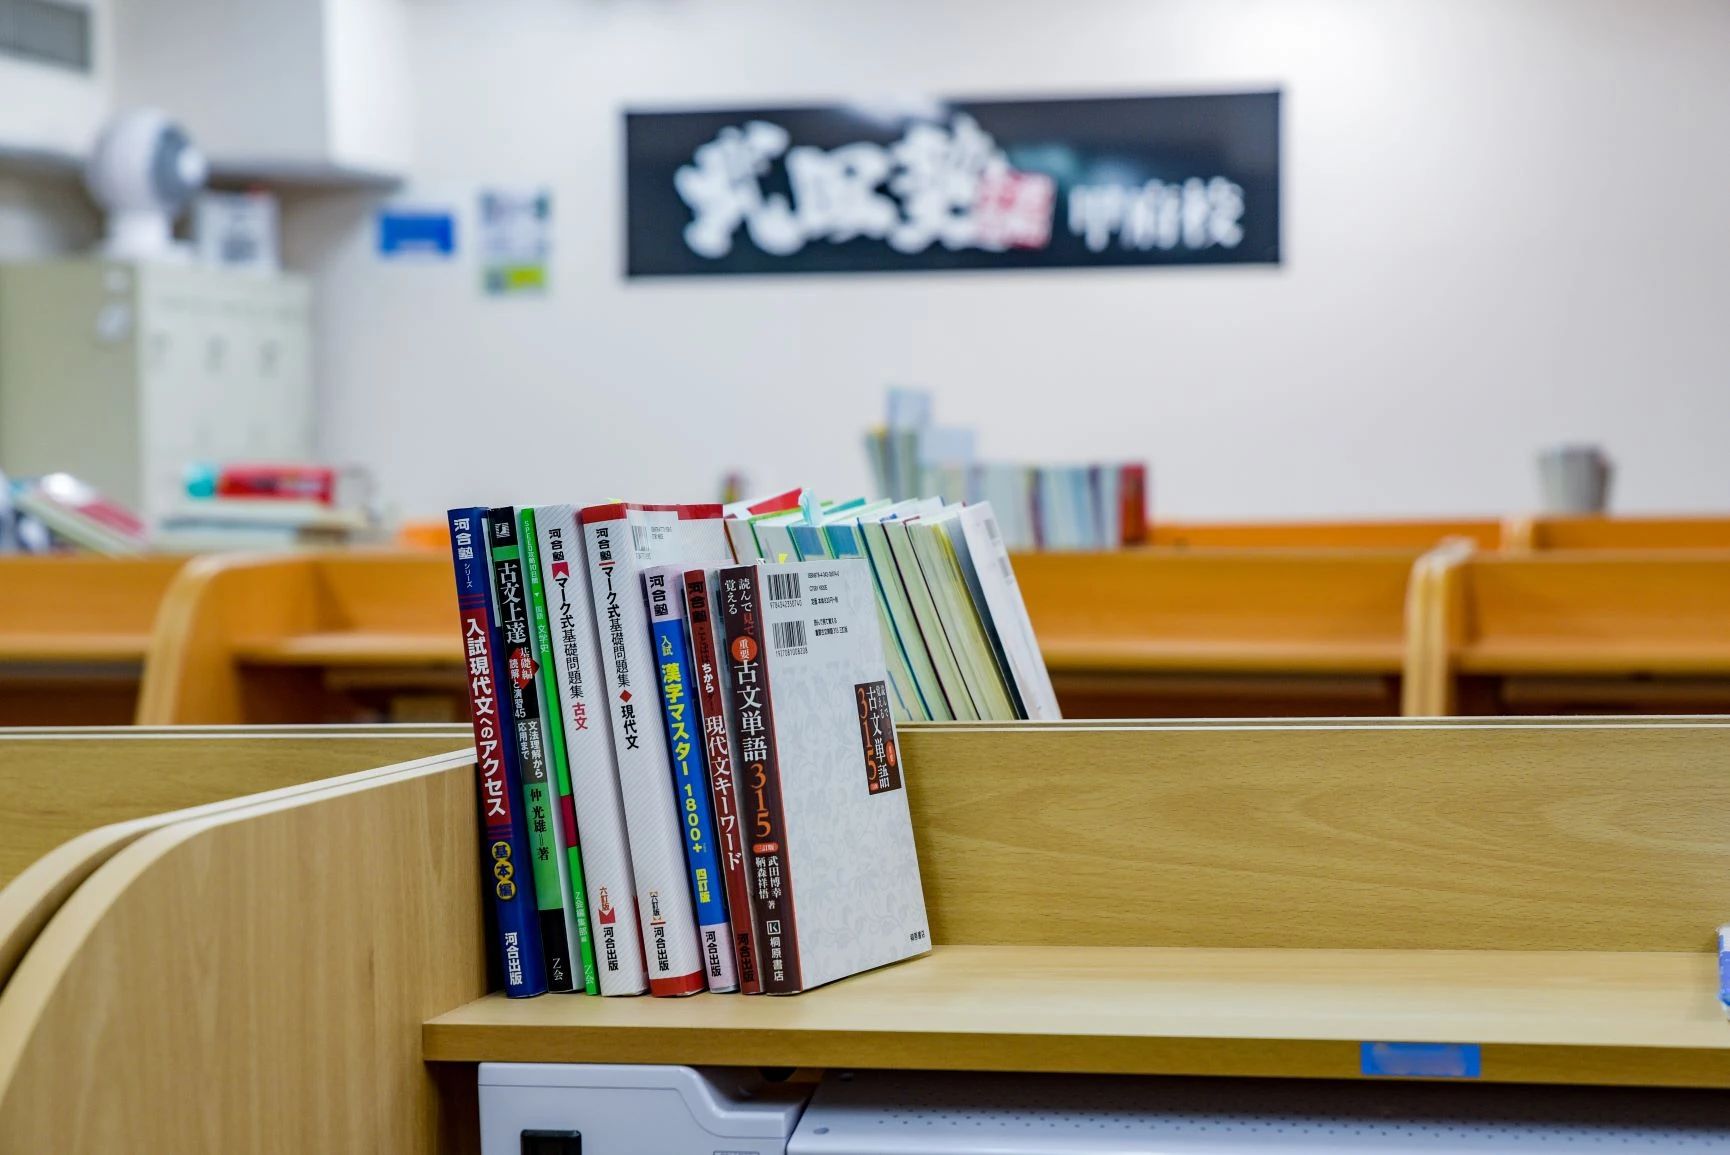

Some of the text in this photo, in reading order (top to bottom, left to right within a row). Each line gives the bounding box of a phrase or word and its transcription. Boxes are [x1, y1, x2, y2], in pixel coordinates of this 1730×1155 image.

[454, 518, 473, 560] 河合塾
[548, 528, 564, 560] 河合塾
[596, 528, 612, 561] 河合塾
[464, 563, 473, 588] シリーズ
[649, 575, 668, 616] 河合塾
[725, 579, 738, 615] 覚える
[497, 563, 527, 644] 古文上達
[537, 625, 550, 653] 文学史
[555, 578, 584, 699] マーク式基礎問題集
[601, 566, 630, 688] マーク式基礎問題集
[661, 635, 673, 656] 入試
[466, 618, 506, 816] 入試現代文へのアクセス
[572, 702, 588, 731] 古文
[620, 704, 639, 750] 現代文
[662, 662, 691, 775] 漢字マスター
[857, 687, 877, 780] 315
[866, 686, 890, 789] 古文単語
[518, 722, 529, 759] 応用まで
[528, 721, 543, 778] 文法理解から
[705, 715, 741, 870] 現代文キーワード
[494, 843, 514, 898] 基本編
[768, 855, 782, 898] 武田博幸
[505, 932, 522, 985] 河合出版
[603, 926, 618, 971] 河合出版
[654, 926, 669, 972] 河合出版
[705, 931, 721, 977] 河合出版
[770, 937, 784, 982] 桐原書店
